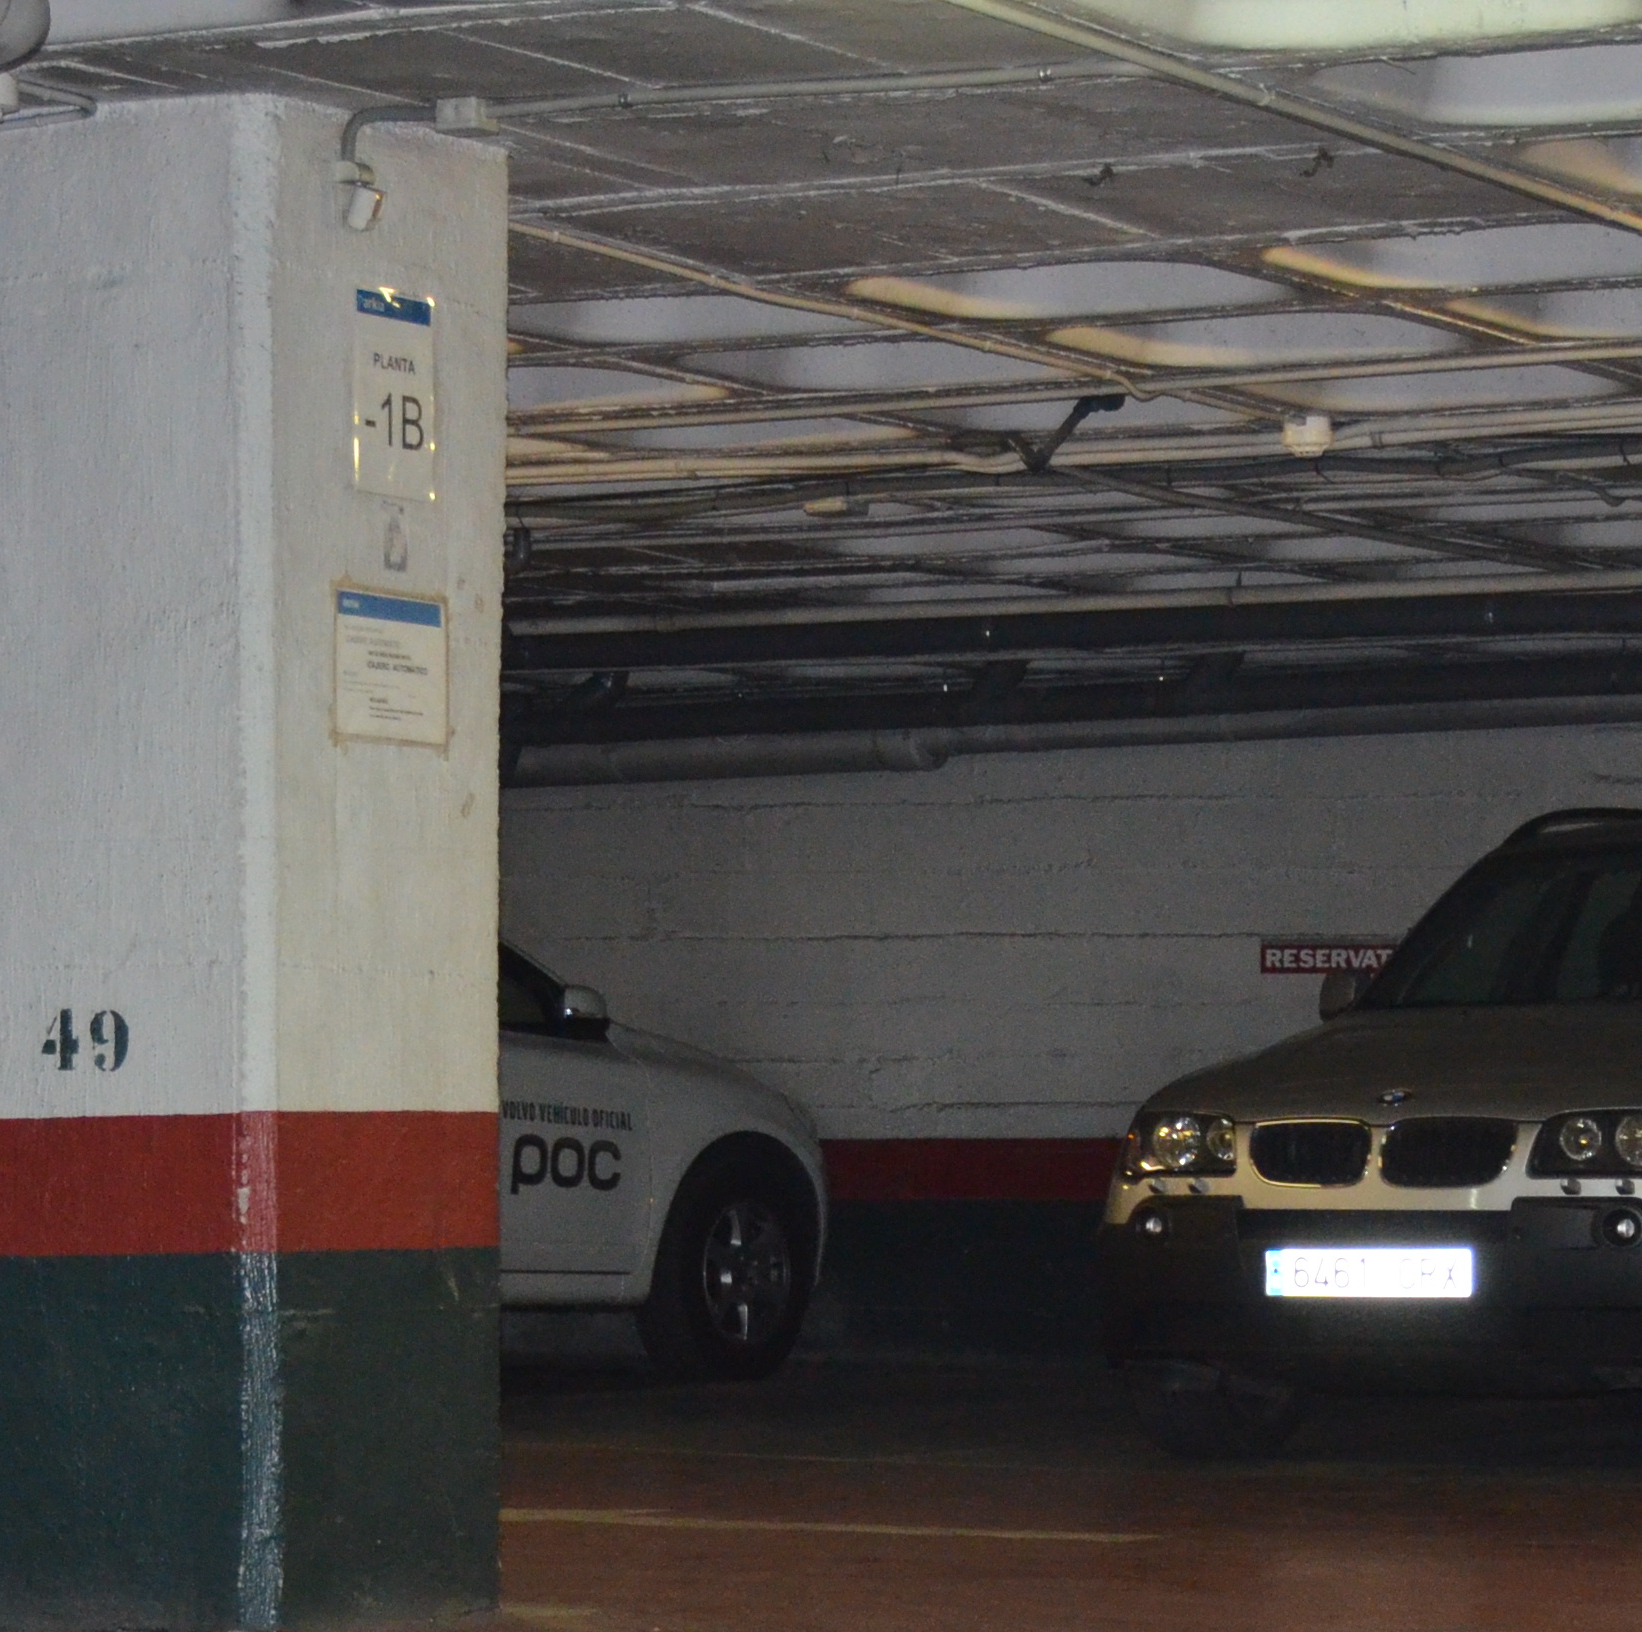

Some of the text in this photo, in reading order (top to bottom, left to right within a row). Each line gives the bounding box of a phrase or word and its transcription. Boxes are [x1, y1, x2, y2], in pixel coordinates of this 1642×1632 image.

[373, 353, 416, 375] PLANTA
[365, 393, 424, 451] -1B
[41, 1008, 129, 1072] 49
[502, 1100, 536, 1121] VOLVO
[591, 1108, 633, 1131] OFICIAL
[1293, 1256, 1366, 1289] 6461
